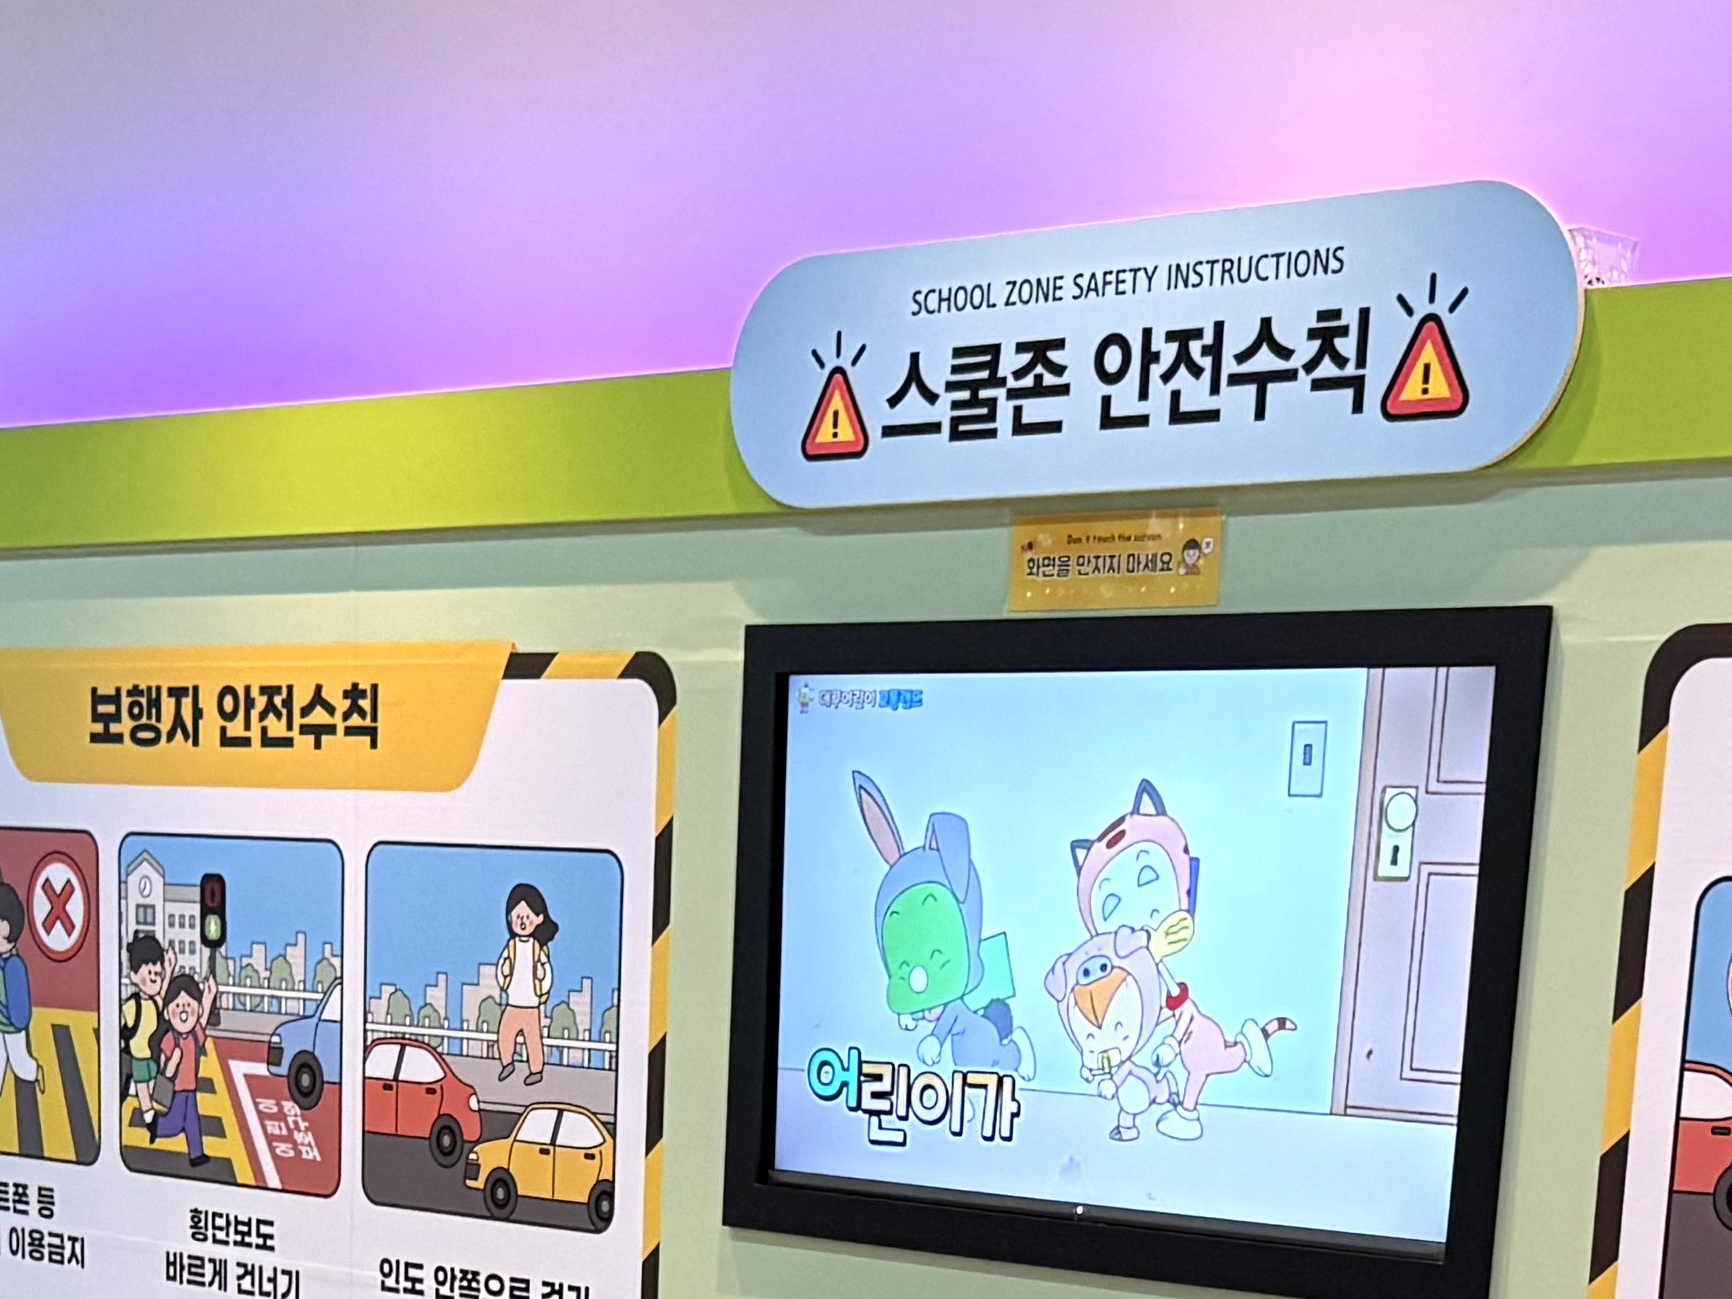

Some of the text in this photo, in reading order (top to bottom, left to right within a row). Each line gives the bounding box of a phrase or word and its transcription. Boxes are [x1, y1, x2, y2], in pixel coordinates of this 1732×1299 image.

[911, 246, 1345, 317] SCHOOL ZONE SAFETY INSTRUCTIONS
[881, 306, 1371, 442] 스쿨존 안전수칙
[1027, 551, 1173, 578] 화면을 만지지 마세요
[89, 682, 379, 750] 보행자 안전수칙
[807, 1046, 1021, 1147] 어린이가
[37, 1186, 56, 1220] 등
[8, 1226, 86, 1269] 이용금지
[189, 1207, 276, 1253] 횡단보도
[165, 1250, 228, 1293] 바르게
[379, 1257, 425, 1297] 인도
